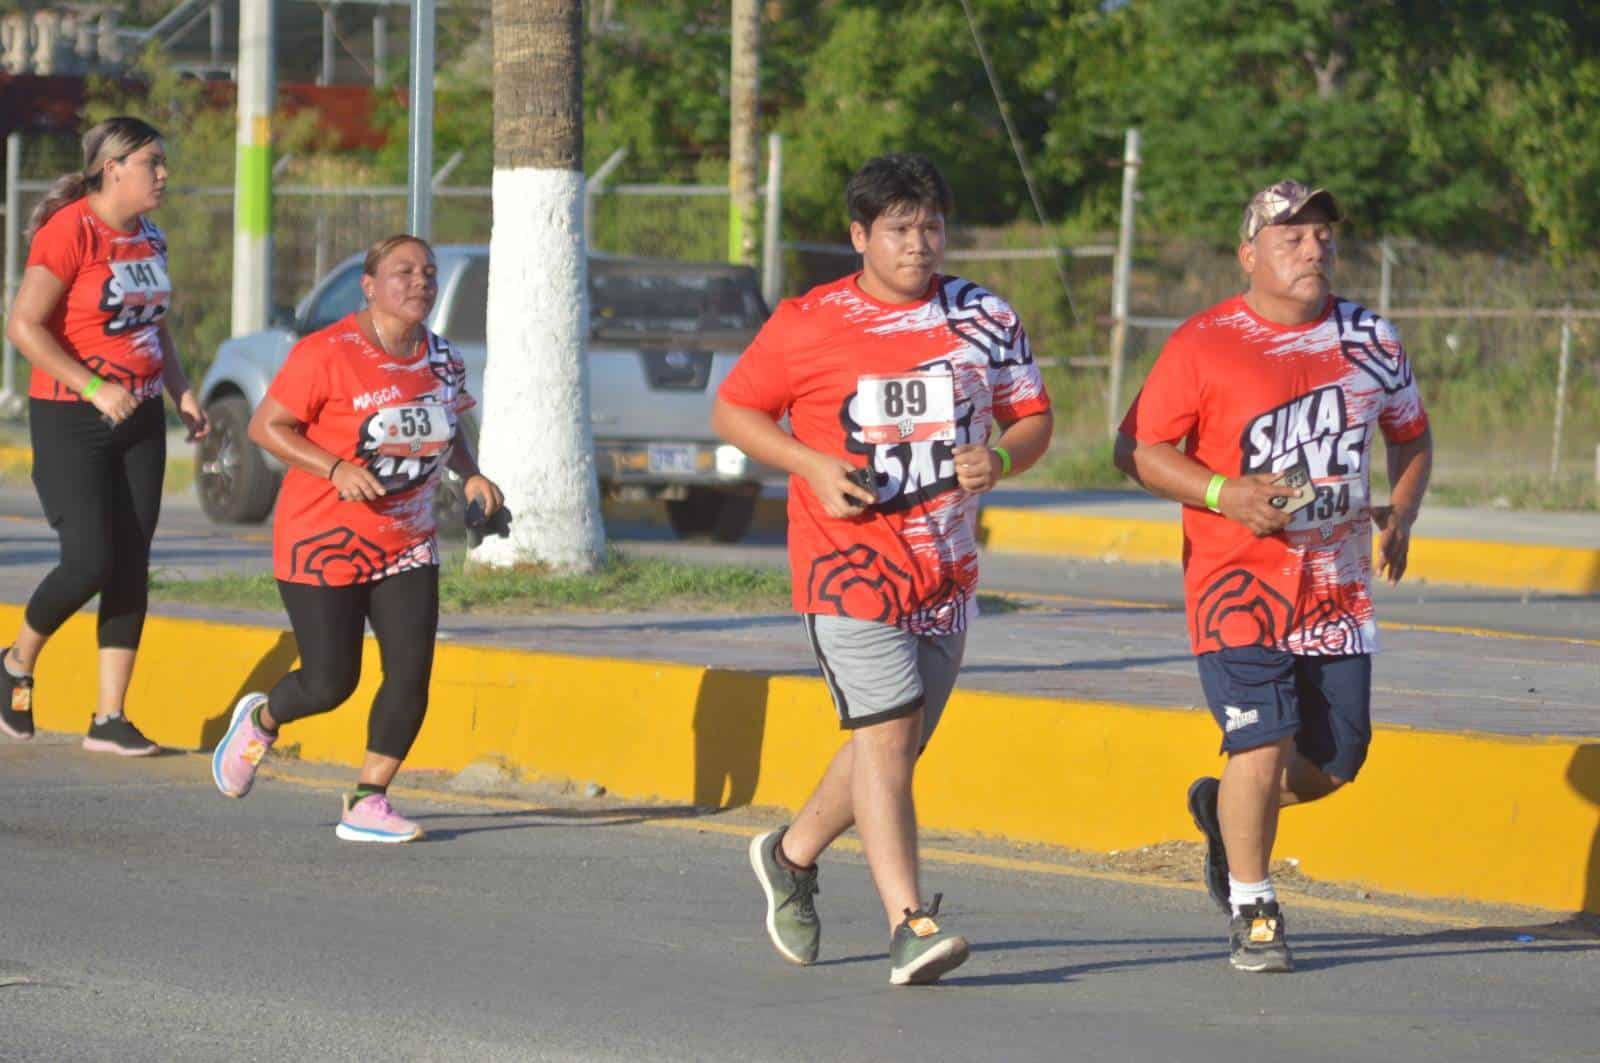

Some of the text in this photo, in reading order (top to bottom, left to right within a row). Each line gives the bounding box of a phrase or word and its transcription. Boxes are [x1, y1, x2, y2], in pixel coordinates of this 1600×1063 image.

[125, 263, 159, 287] 141
[352, 384, 402, 411] MAGDA
[884, 379, 927, 417] 89
[400, 407, 432, 437] 53
[1249, 388, 1341, 469] SIKA
